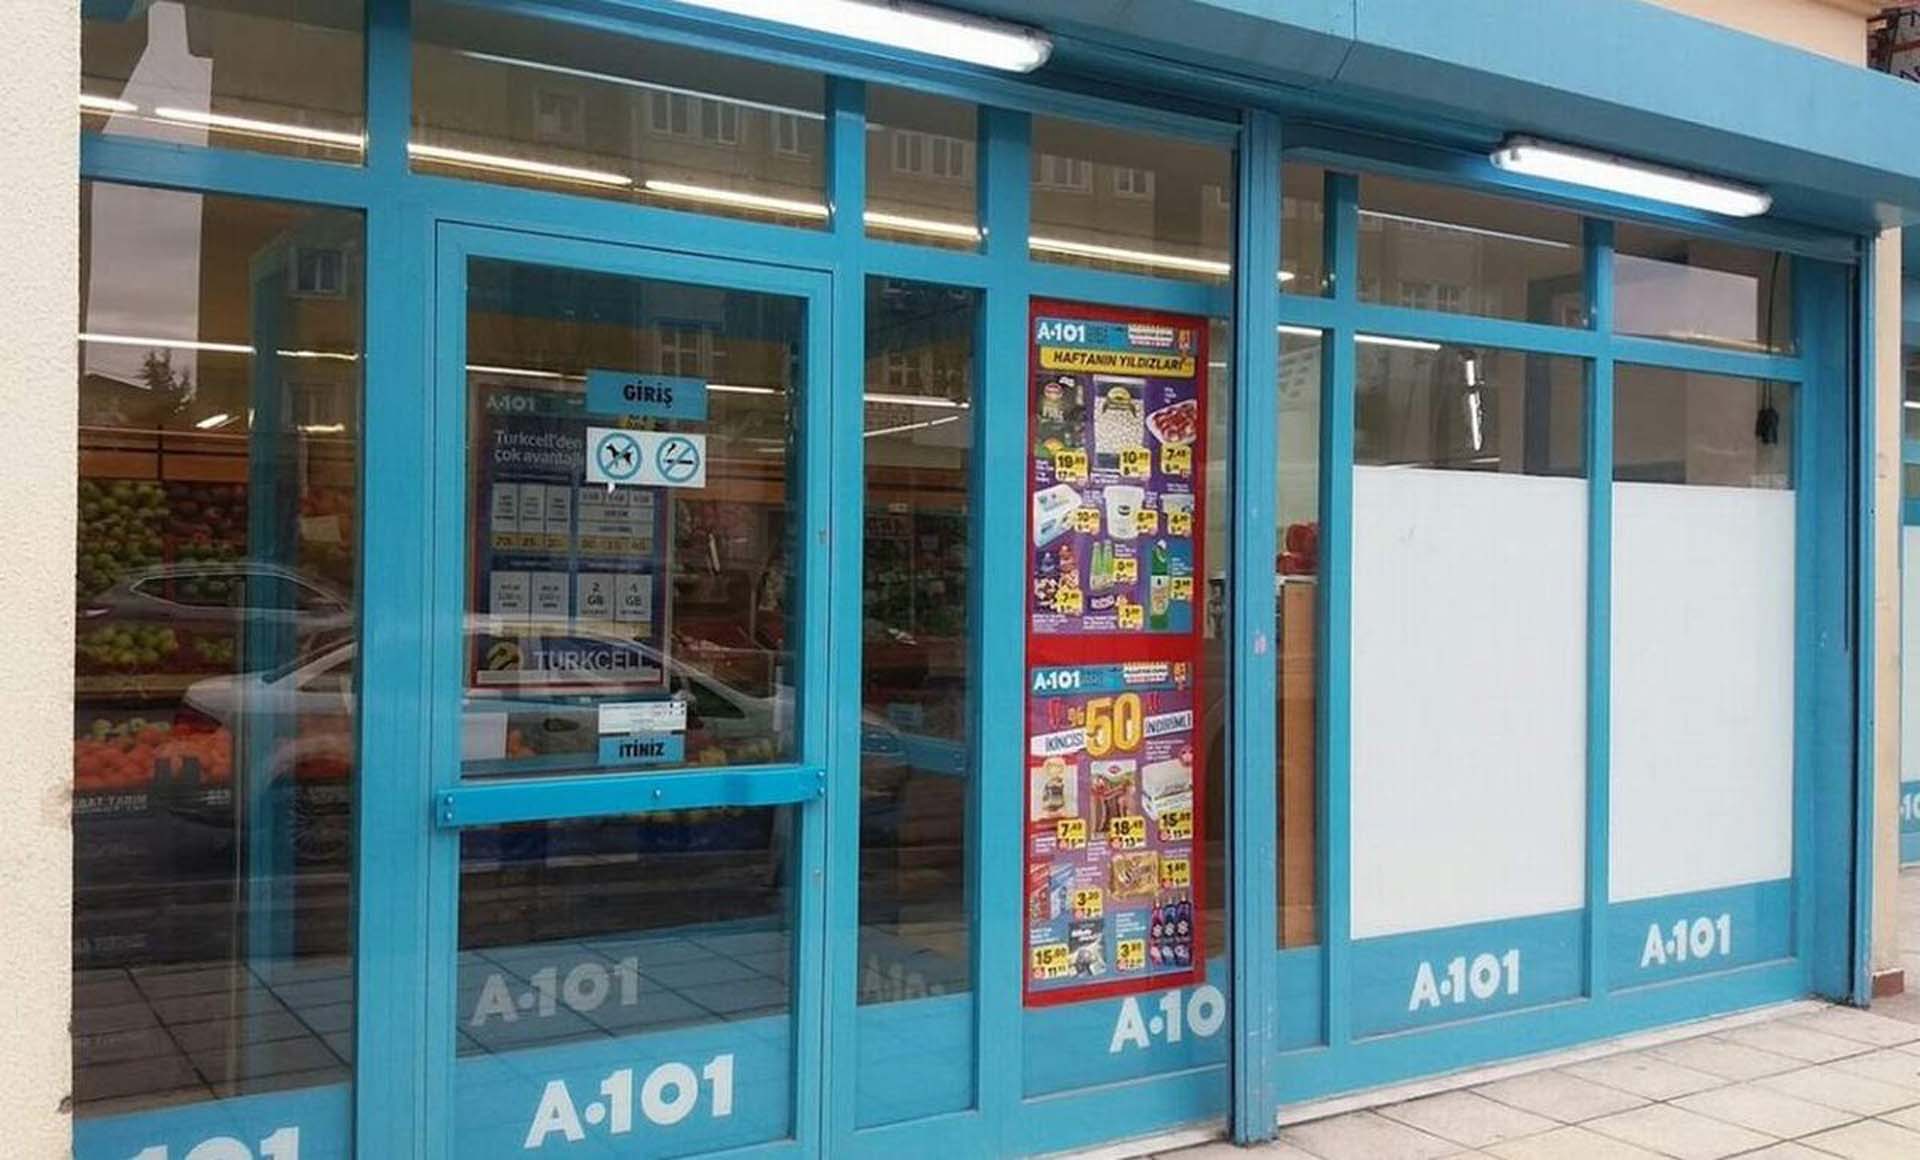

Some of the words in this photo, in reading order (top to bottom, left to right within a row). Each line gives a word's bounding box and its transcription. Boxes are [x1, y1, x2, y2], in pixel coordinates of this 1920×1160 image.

[1053, 351, 1117, 367] HAFTANIN
[623, 380, 673, 409] GİRİŞ
[532, 650, 645, 672] TURKCELL
